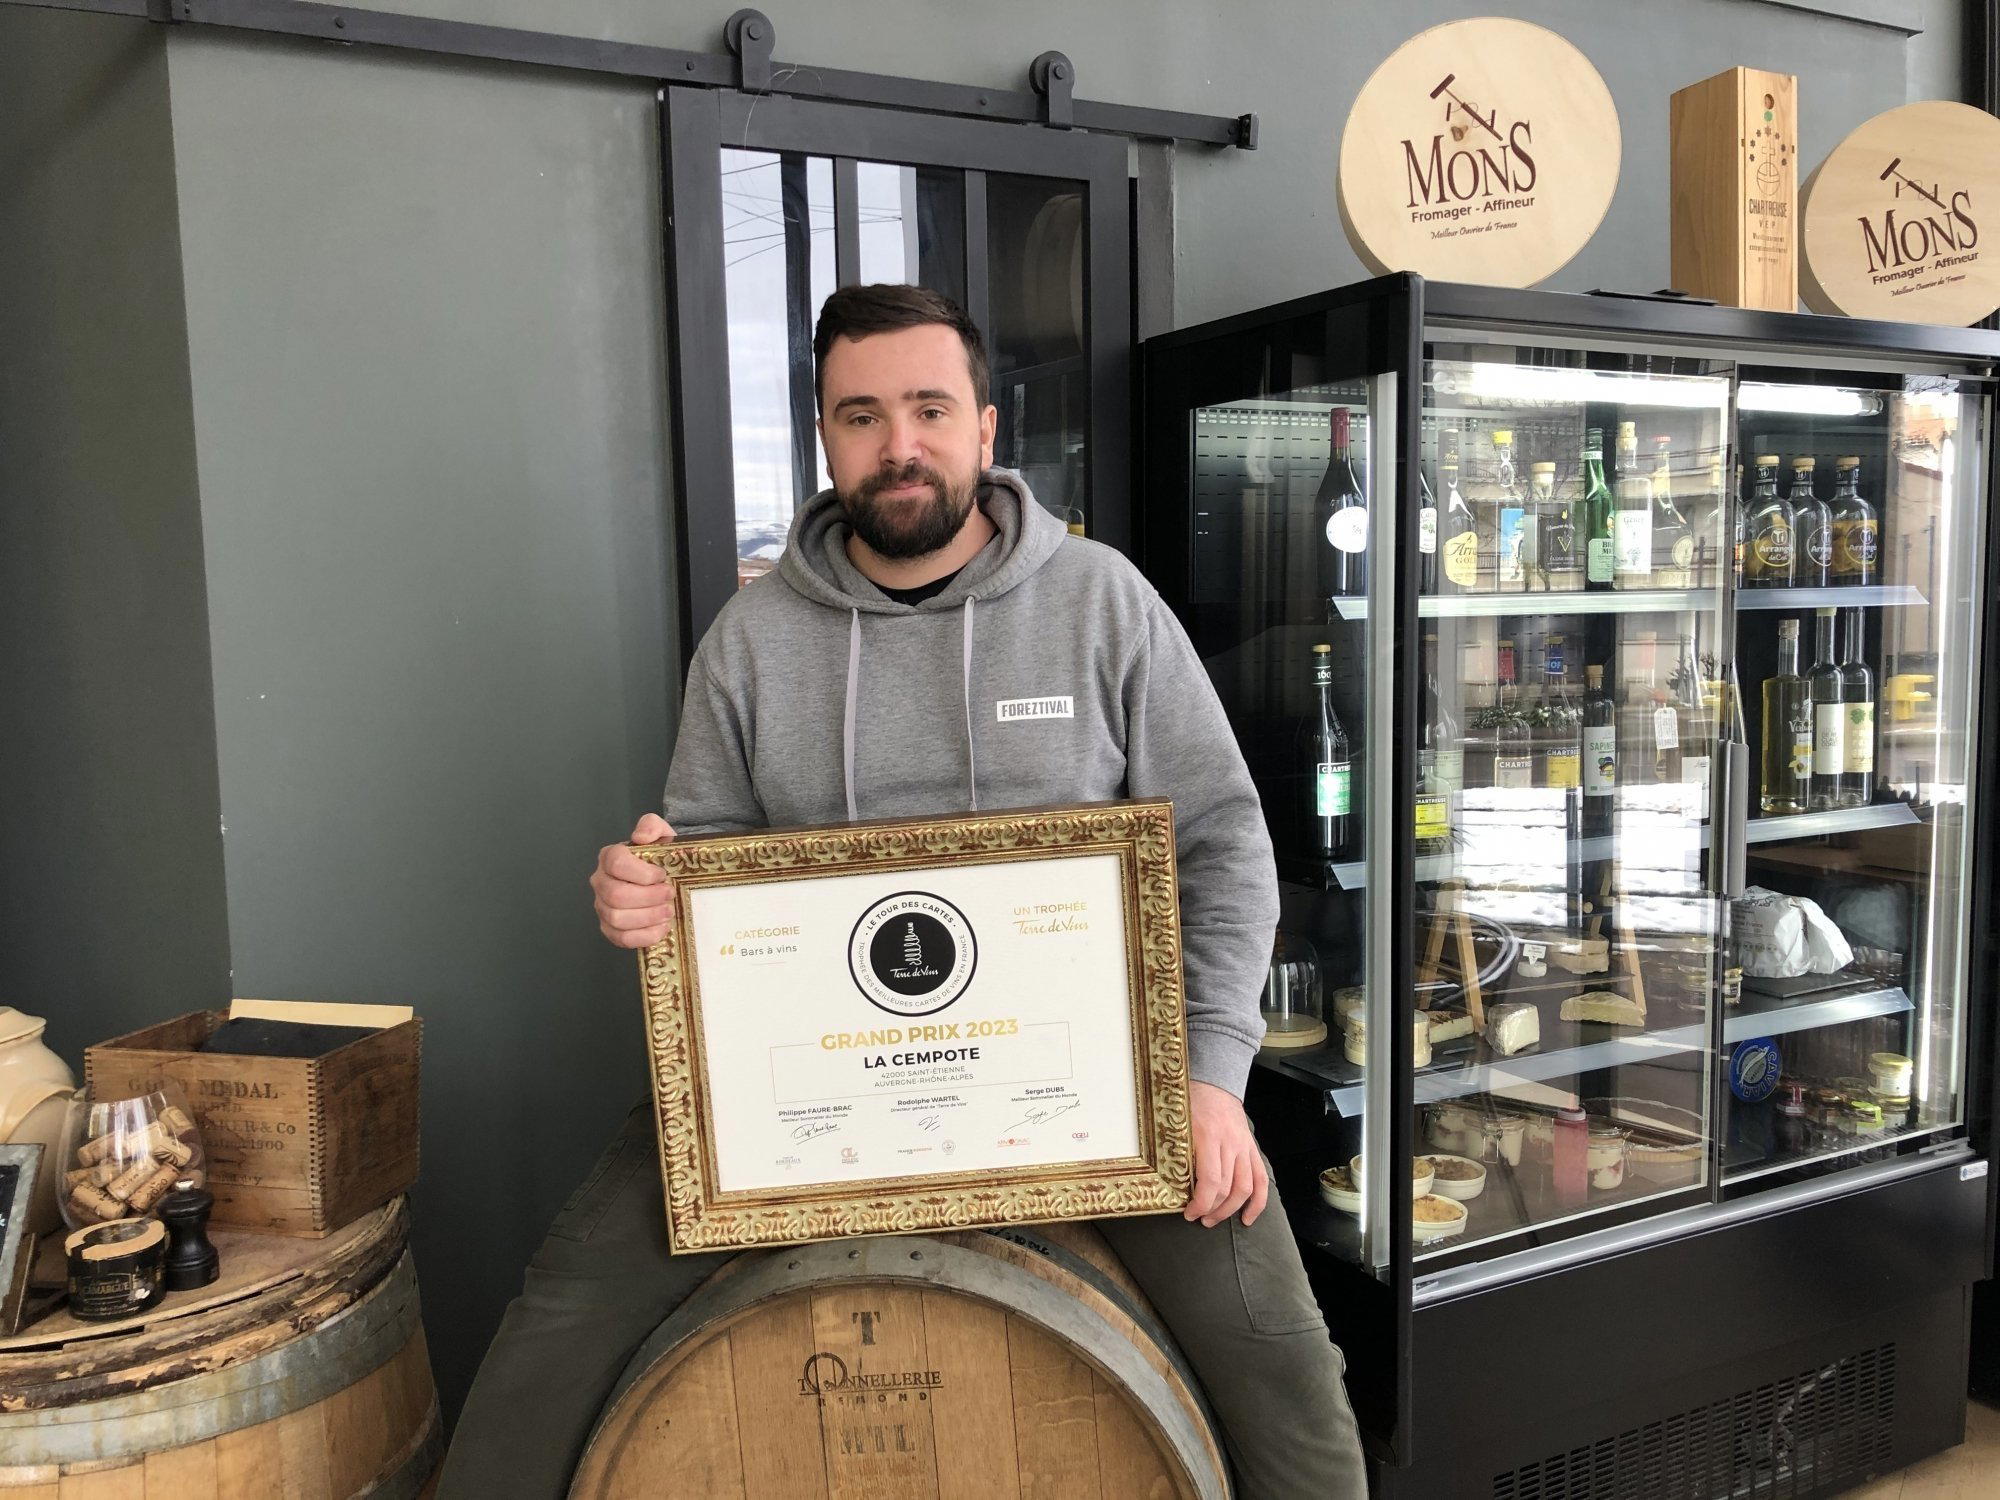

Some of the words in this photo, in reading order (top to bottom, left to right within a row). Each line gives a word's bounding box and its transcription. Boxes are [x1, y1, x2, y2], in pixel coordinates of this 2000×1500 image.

[1412, 205, 1472, 223] Fromager
[1483, 197, 1535, 212] Affineur
[1431, 228, 1458, 240] Meilleur
[1459, 226, 1484, 236] Ouvrier
[1485, 222, 1492, 232] de
[1494, 222, 1518, 230] France
[1872, 266, 1925, 285] Fromager
[1935, 252, 1979, 270] Affineur
[1002, 700, 1068, 717] FOREZTIVAL
[867, 920, 876, 930] LE
[876, 904, 899, 921] TOUR
[922, 903, 954, 923] CARTES
[1014, 906, 1030, 916] UN
[1034, 901, 1087, 914] TROPHÉE
[735, 926, 800, 940] CATÉGORIE
[1013, 920, 1046, 935] Terre
[1048, 919, 1063, 932] de
[1062, 916, 1089, 931] Vins
[741, 948, 764, 956] Bars
[768, 946, 773, 954] à
[776, 945, 798, 954] vins
[890, 968, 911, 979] Terre
[912, 967, 921, 977] de
[920, 965, 939, 976] Vins
[864, 974, 874, 988] DES
[874, 986, 913, 1007] MEILLEURES
[915, 995, 941, 1007] CARTES
[942, 988, 950, 997] DE
[949, 974, 962, 989] VINS
[959, 964, 966, 974] EN
[821, 1028, 903, 1050] GRAND
[908, 1024, 961, 1043] PRIX
[966, 1018, 1018, 1038] 2023
[864, 1056, 887, 1069] LA
[892, 1047, 980, 1067] CEMPOTE
[874, 1074, 974, 1088] AUVERGNE-RHÔNE-ALPES
[881, 1071, 905, 1079] 42000
[908, 1066, 965, 1077] SAINT-ÉTIENNE
[1743, 1052, 1778, 1098] CAVIAR
[198, 1079, 278, 1099] MEDAL
[898, 1098, 930, 1106] Rodolphe
[260, 1122, 272, 1134] &
[276, 1122, 296, 1135] Co
[853, 1311, 881, 1345] T
